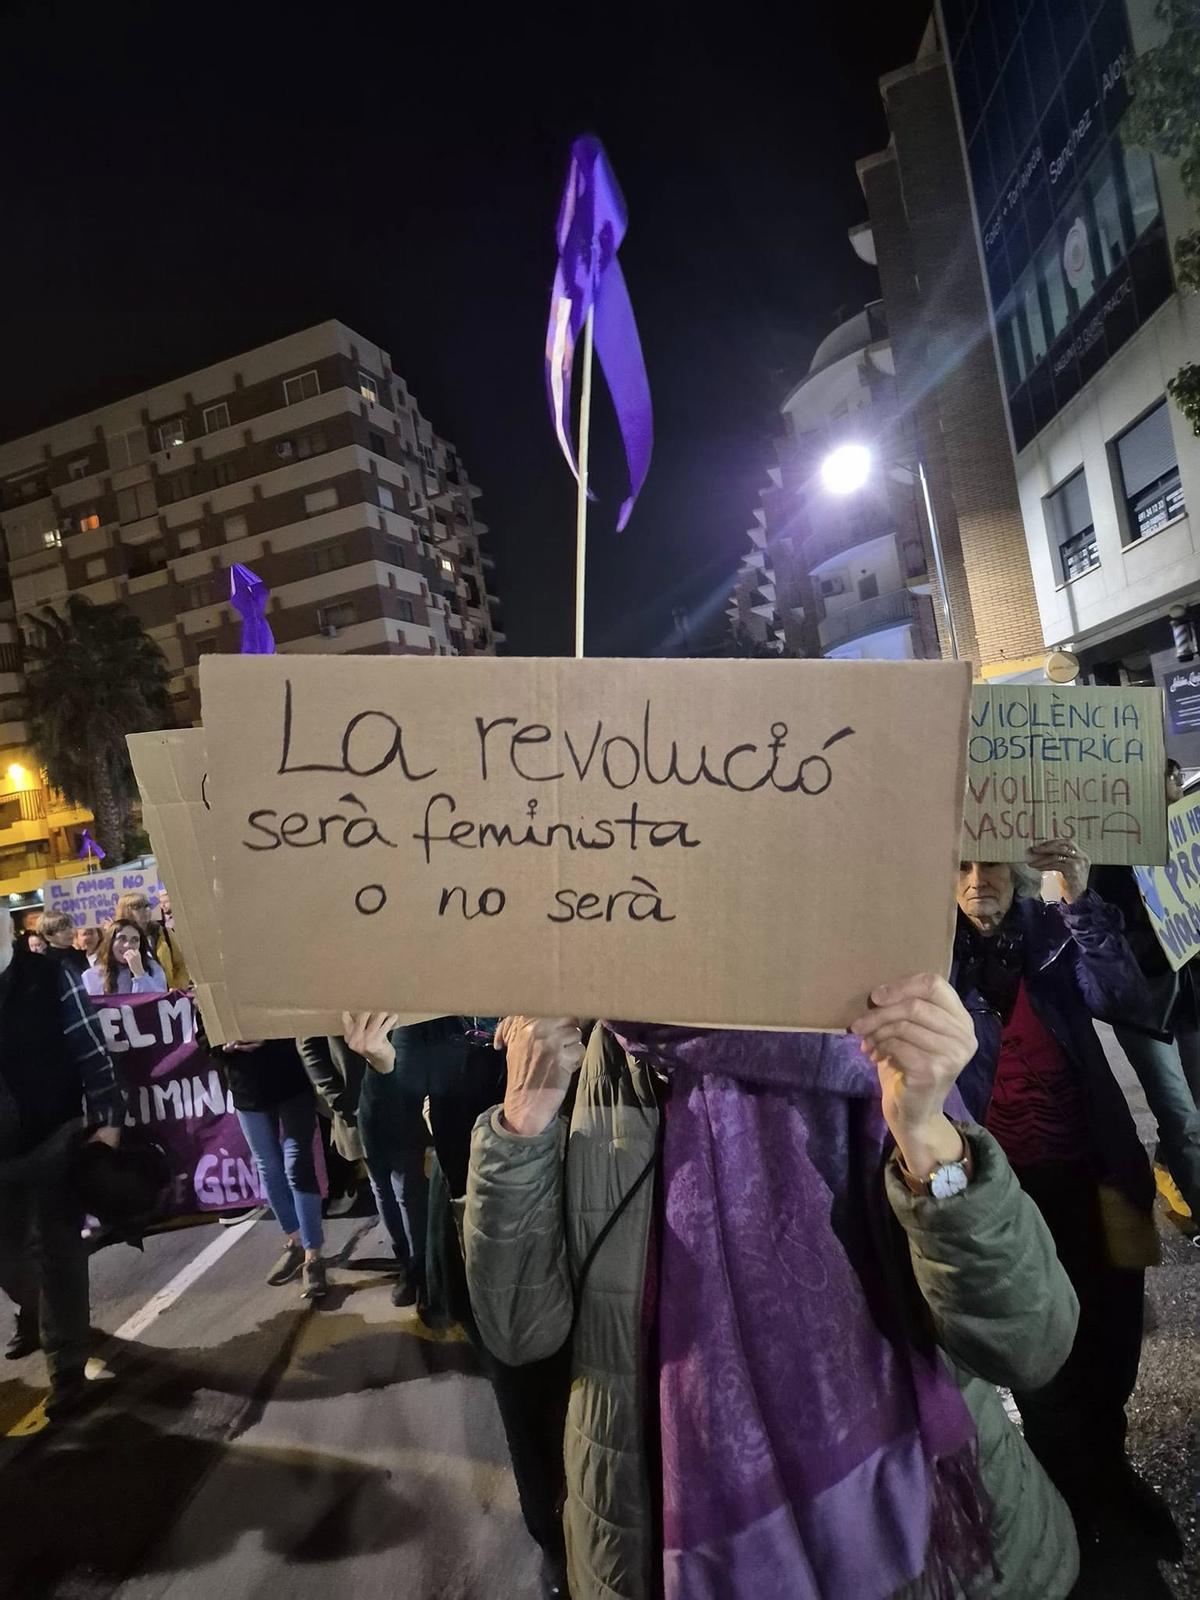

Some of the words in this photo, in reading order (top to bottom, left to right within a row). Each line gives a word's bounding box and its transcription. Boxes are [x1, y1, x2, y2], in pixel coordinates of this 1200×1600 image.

[276, 678, 438, 782] La
[474, 699, 857, 797] revolució
[242, 791, 399, 853] serà
[412, 791, 703, 866] feminista
[51, 885, 70, 899] EL
[77, 877, 115, 895] AMOR
[123, 875, 144, 889] NO
[354, 883, 389, 917] o
[438, 885, 507, 922] no
[546, 873, 678, 925] serà
[97, 1004, 156, 1053] EL
[158, 996, 199, 1044] M
